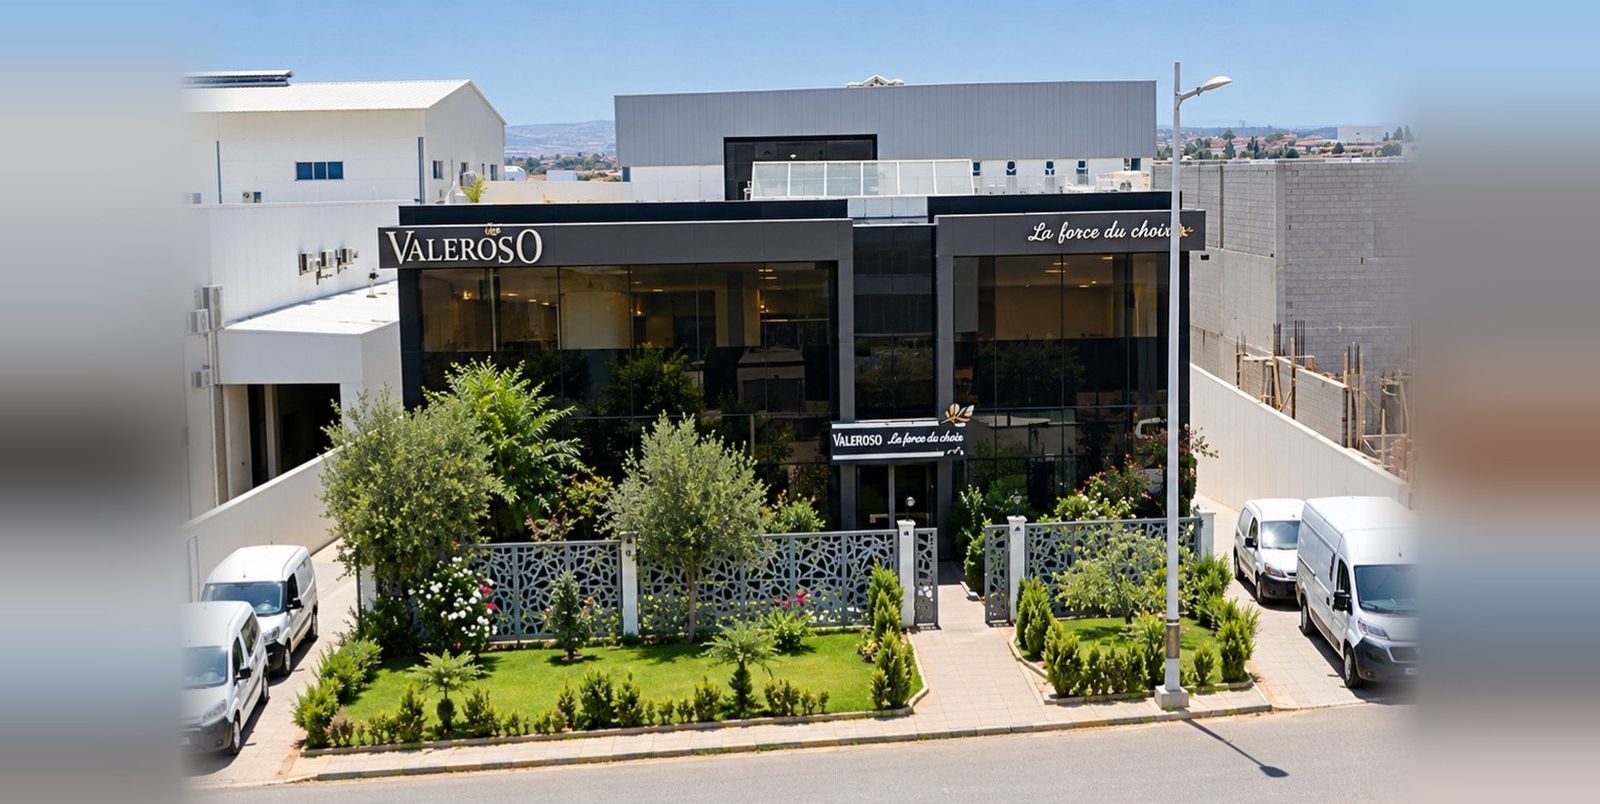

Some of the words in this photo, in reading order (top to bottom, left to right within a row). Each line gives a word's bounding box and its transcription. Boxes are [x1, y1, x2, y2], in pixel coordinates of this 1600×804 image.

[1027, 221, 1054, 242] La
[1058, 221, 1100, 244] force
[1103, 220, 1127, 239] du
[385, 228, 543, 265] VALEROSO
[832, 432, 883, 447] VALEROSO
